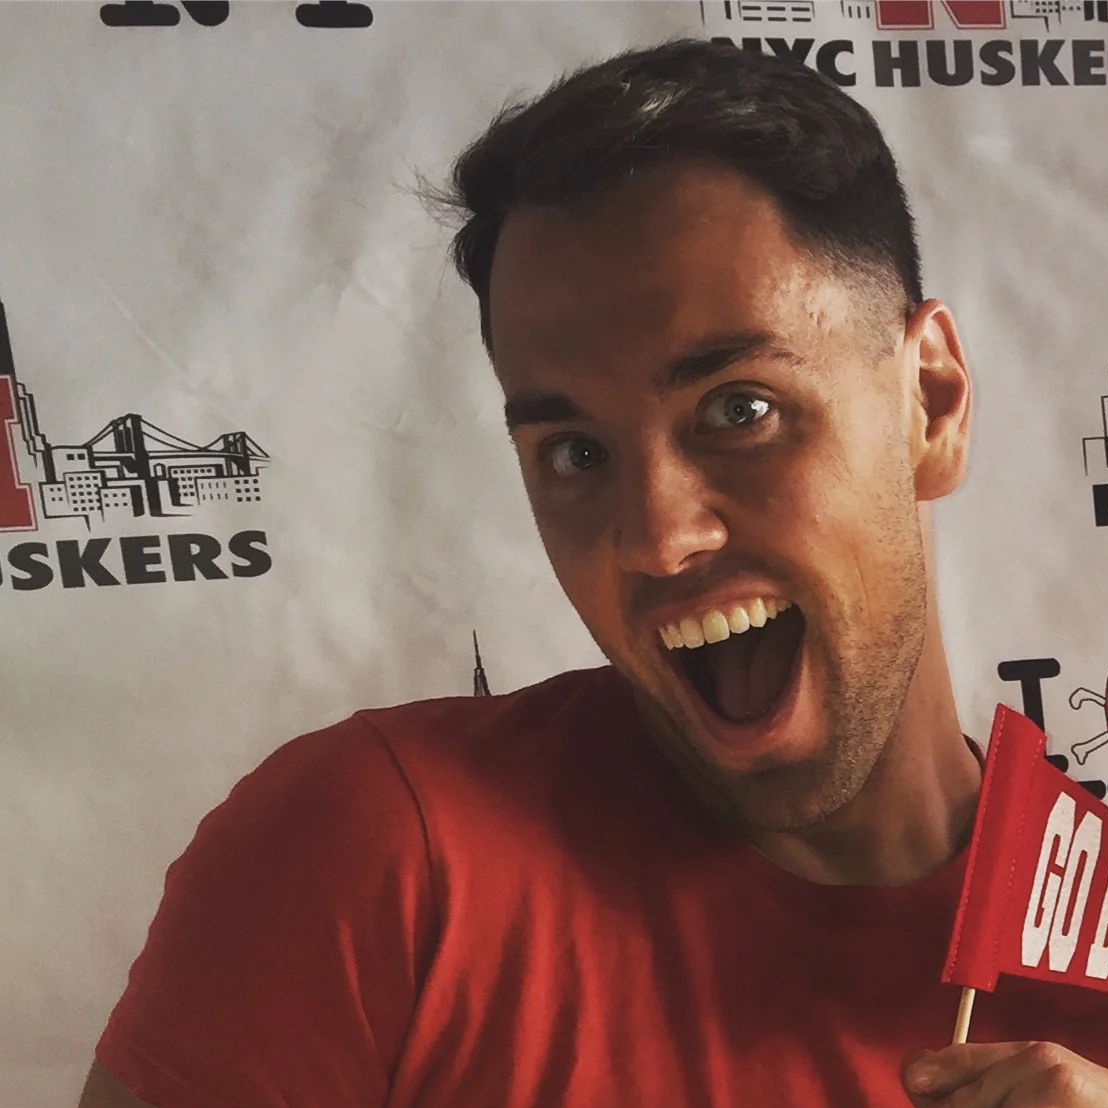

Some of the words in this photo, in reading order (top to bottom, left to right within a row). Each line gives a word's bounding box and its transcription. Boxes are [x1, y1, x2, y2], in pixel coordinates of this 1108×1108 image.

[711, 37, 857, 87] YC
[0, 530, 273, 591] SKERS
[1021, 791, 1103, 973] GO
